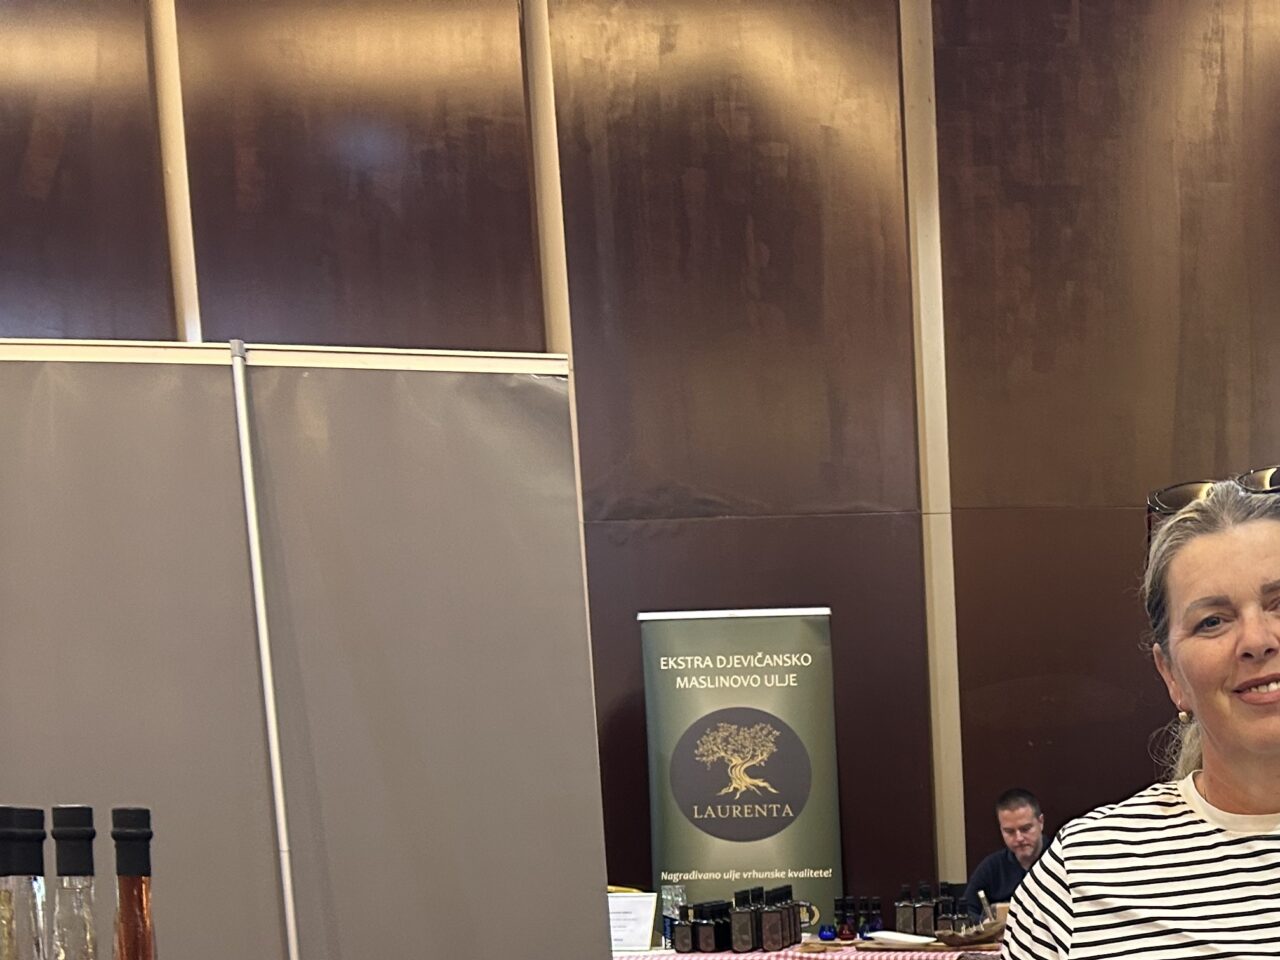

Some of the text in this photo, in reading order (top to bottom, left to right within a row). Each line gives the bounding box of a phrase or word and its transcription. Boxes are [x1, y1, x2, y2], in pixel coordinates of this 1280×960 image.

[660, 652, 812, 669] EKSTRA DJEVIČANSKO
[676, 673, 798, 688] MASLINOVO ULJE
[693, 804, 794, 818] LAURENTA
[723, 869, 741, 881] ulje
[742, 869, 786, 879] vrhunske
[787, 868, 833, 878] kvalitete!
